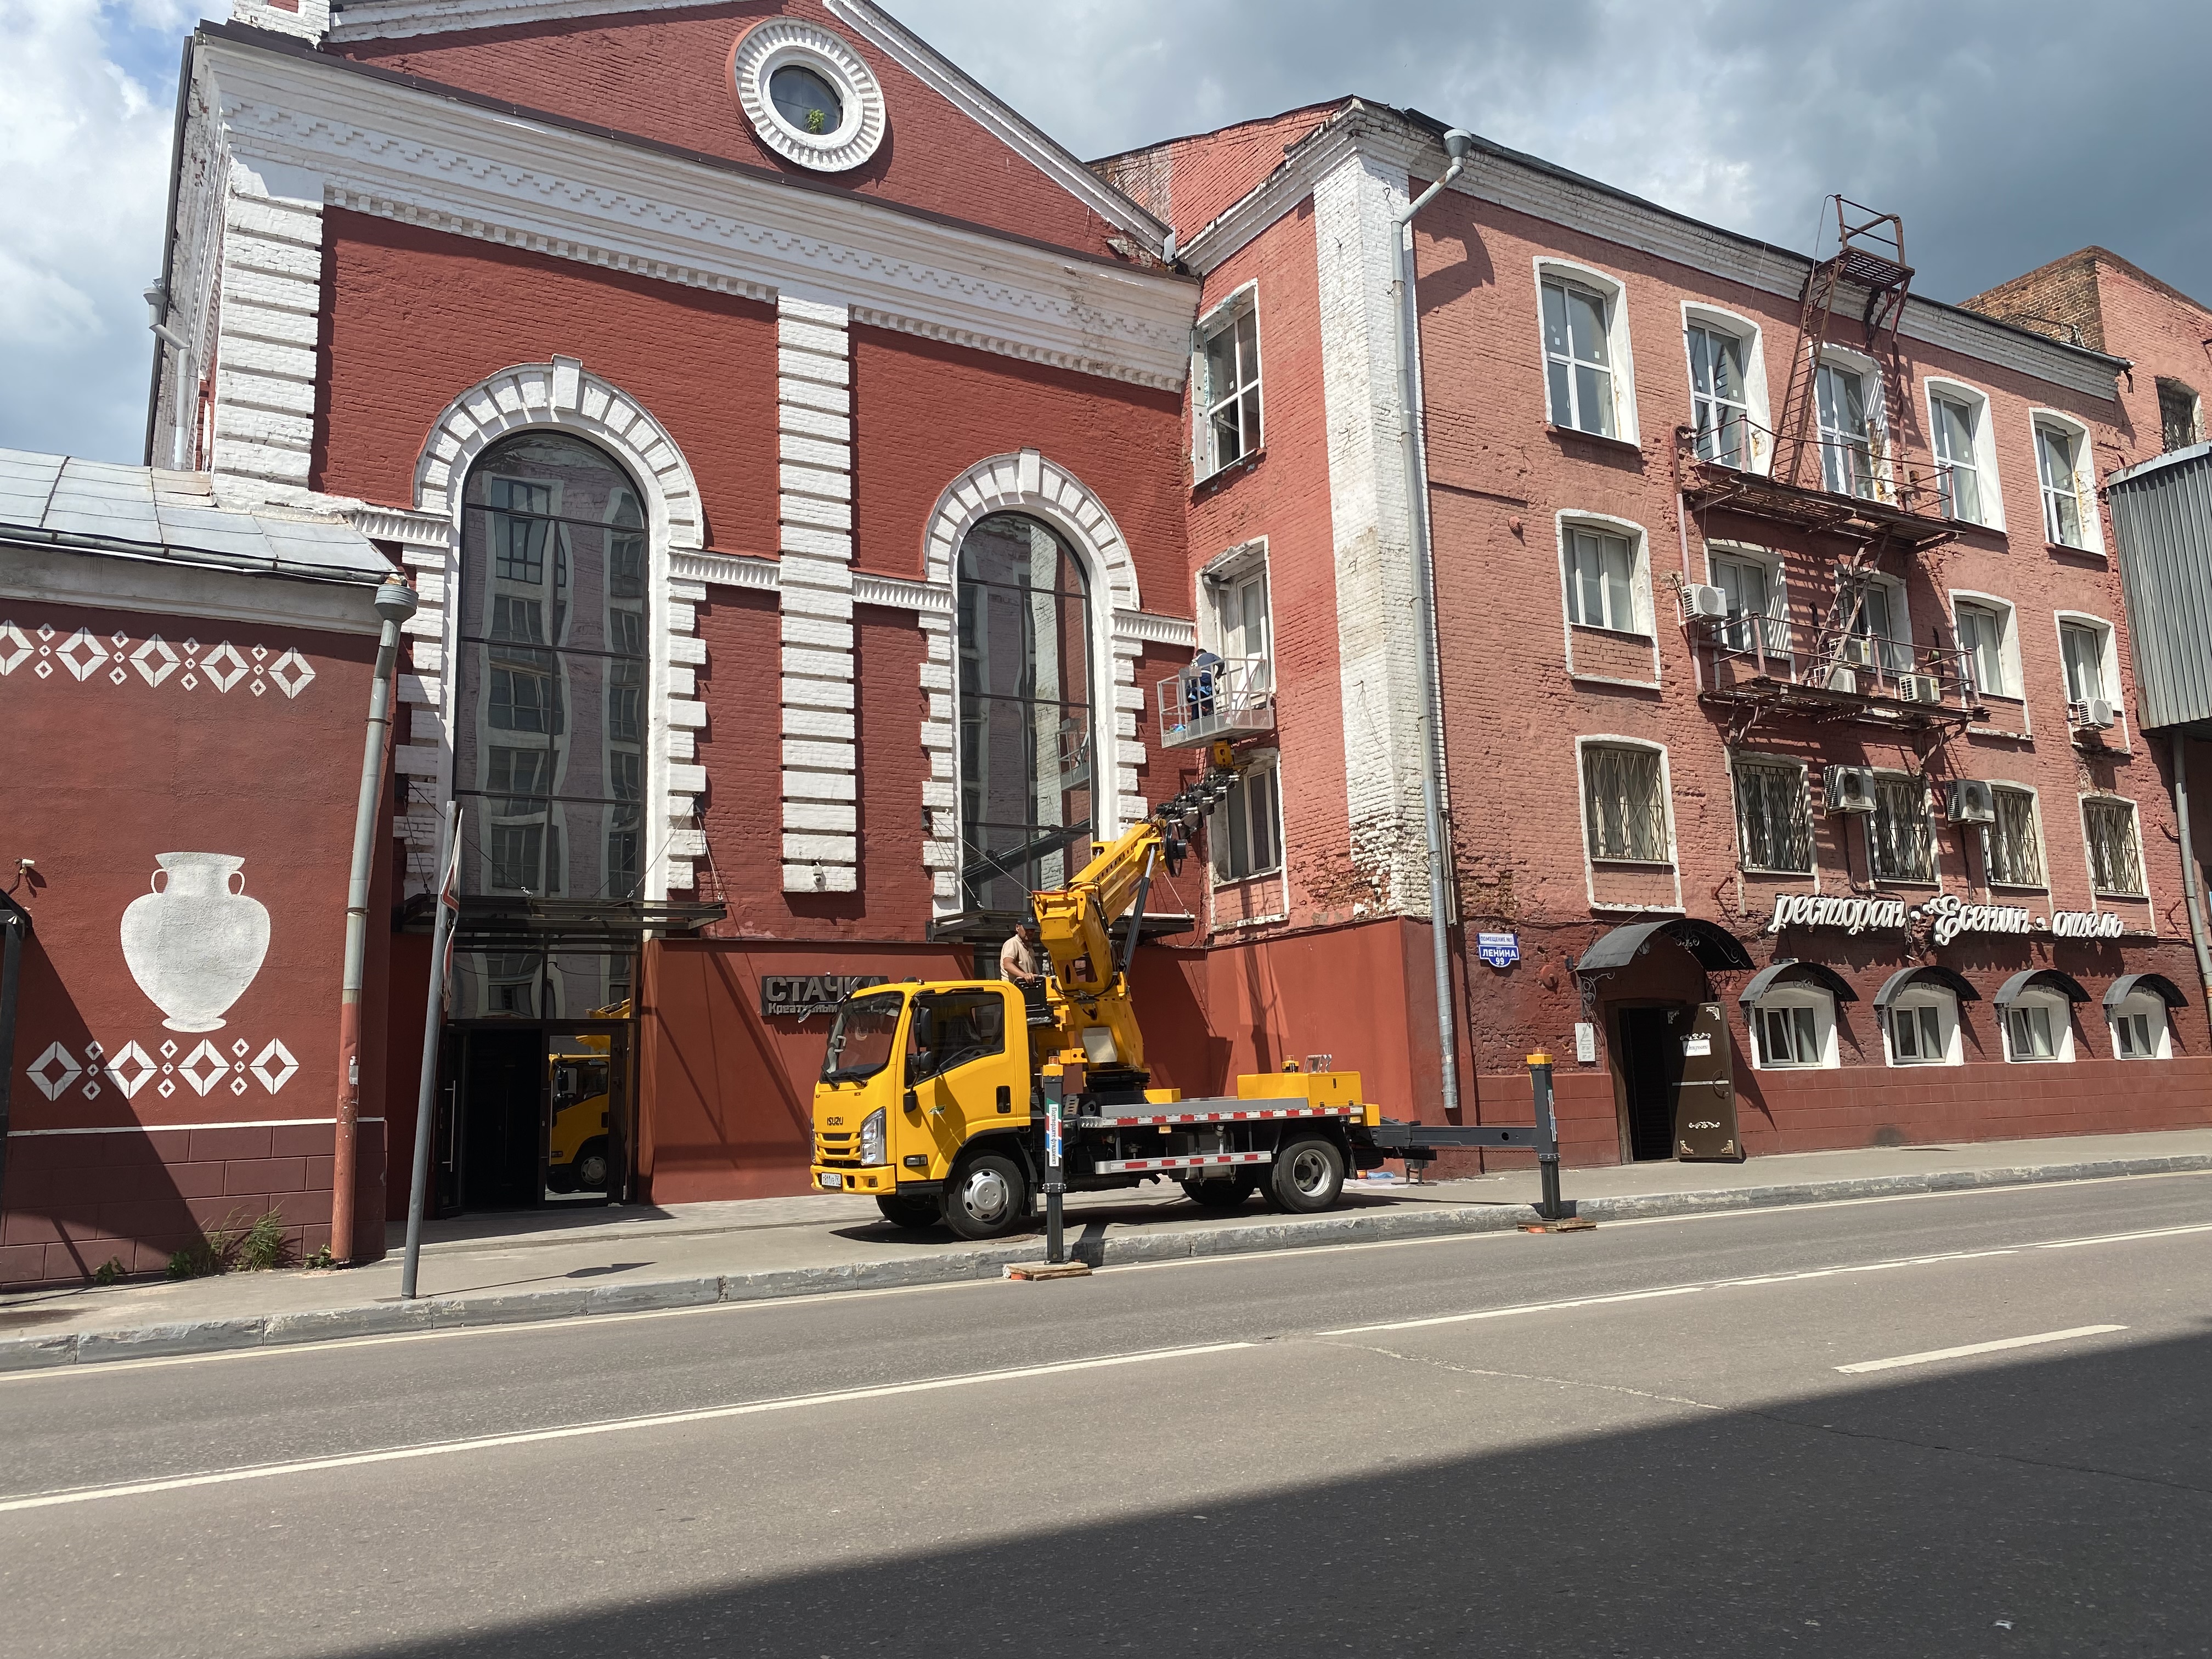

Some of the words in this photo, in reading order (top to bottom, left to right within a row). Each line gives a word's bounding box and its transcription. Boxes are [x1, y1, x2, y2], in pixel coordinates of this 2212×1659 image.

[1767, 895, 1906, 935] ресторан
[1922, 895, 2031, 946] Есенин
[2052, 911, 2124, 938] отель
[1482, 949, 1516, 957] ЛЕНИНА
[827, 1116, 843, 1126] ISUZU
